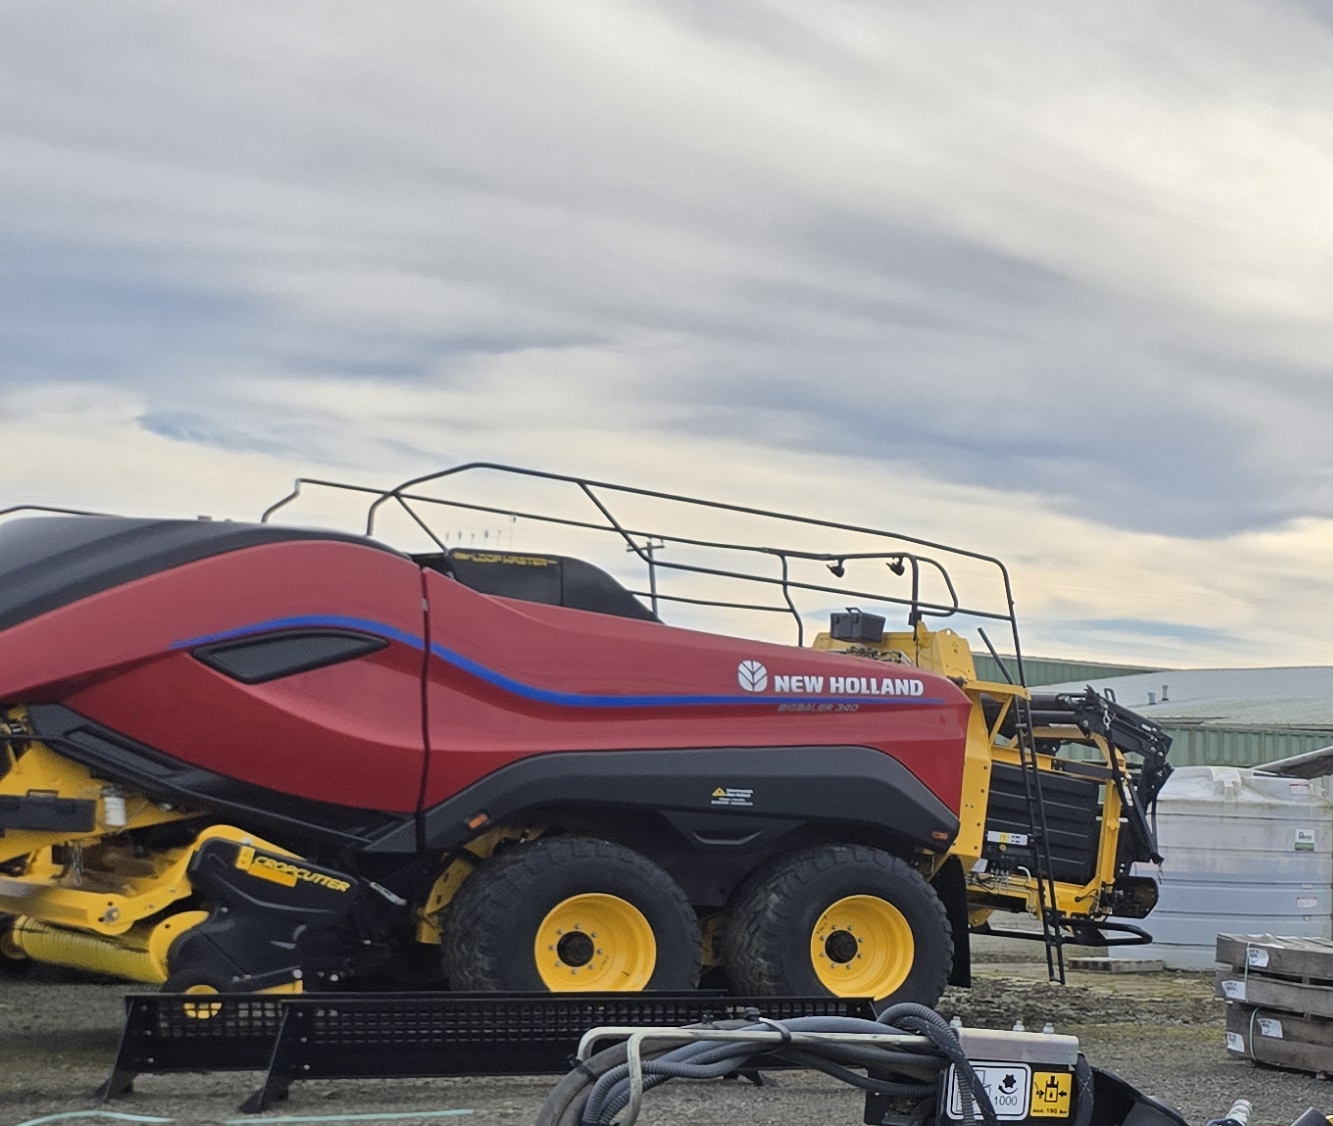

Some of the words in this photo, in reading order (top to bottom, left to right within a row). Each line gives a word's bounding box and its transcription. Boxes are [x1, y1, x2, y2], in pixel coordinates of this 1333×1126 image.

[774, 675, 824, 693] NEW
[829, 677, 924, 696] HOLLAND
[777, 704, 834, 712] BIGBALER
[835, 704, 859, 712] 340
[254, 856, 351, 892] CROPCUTTER
[994, 1096, 1018, 1106] 1000
